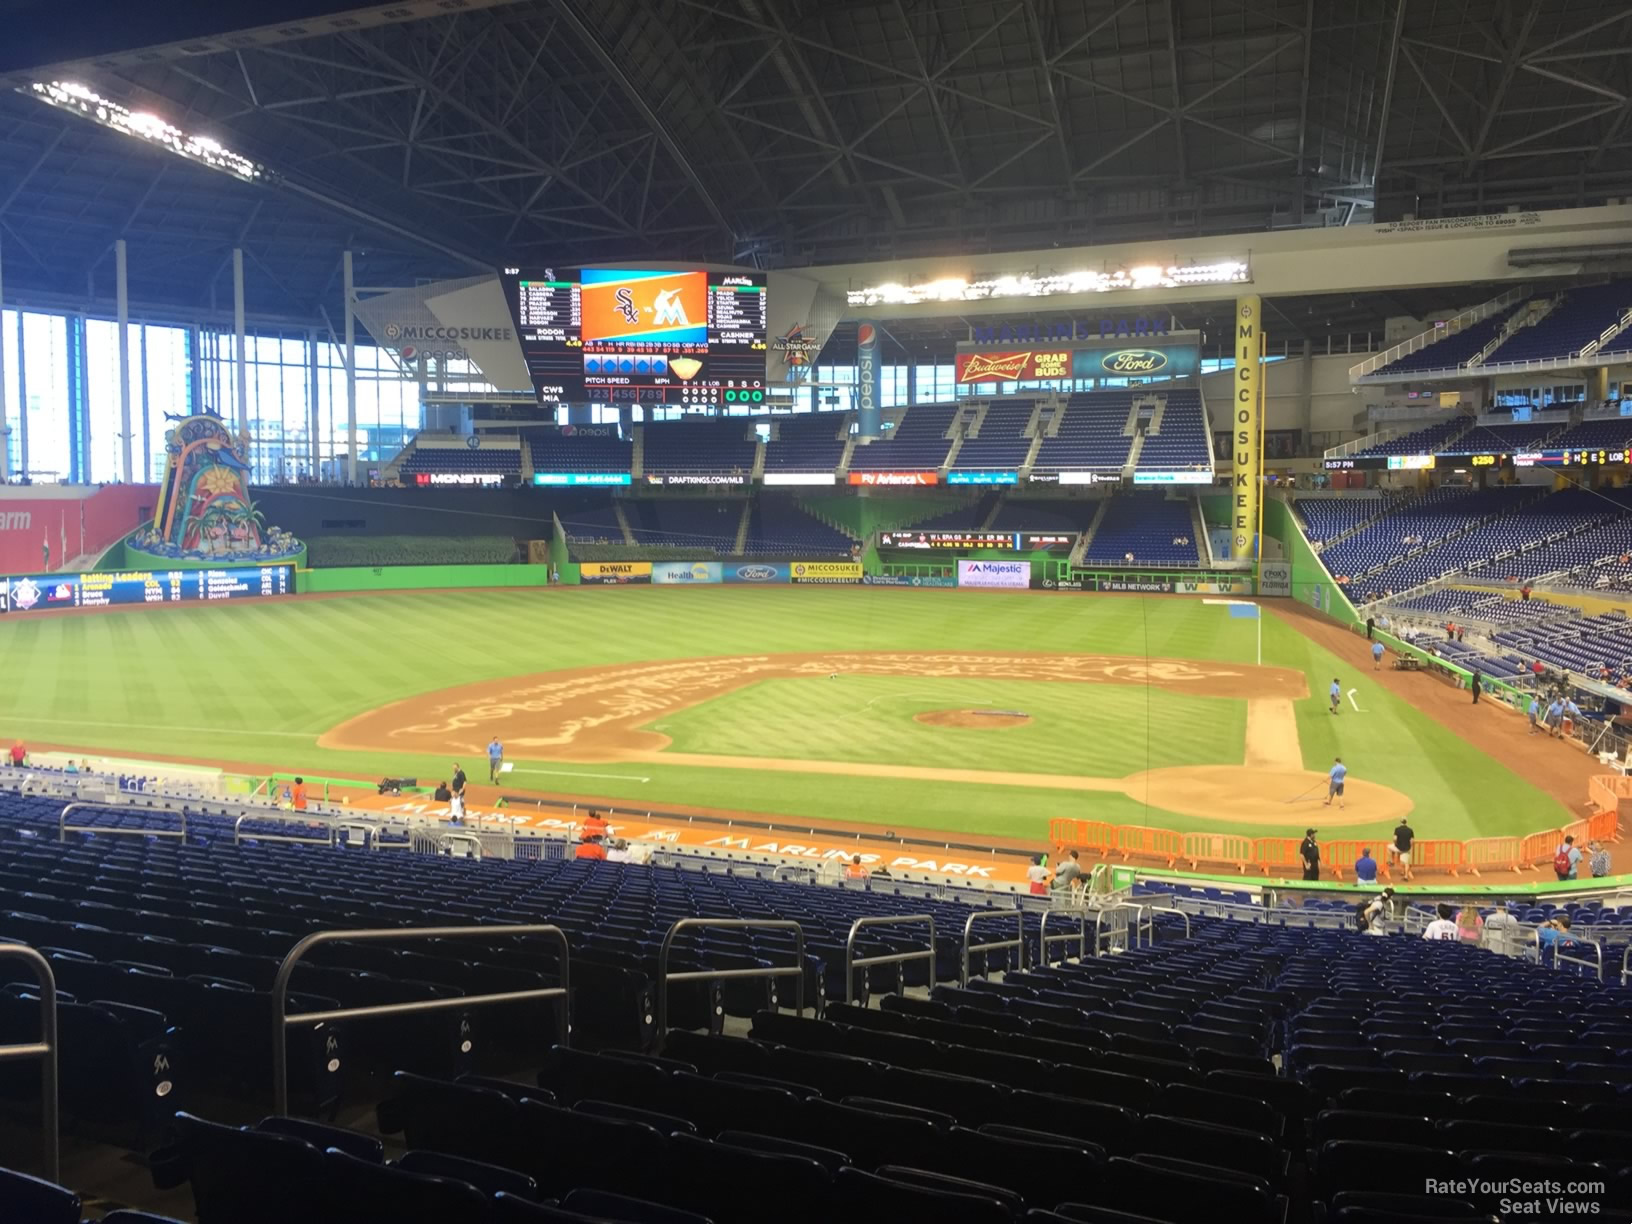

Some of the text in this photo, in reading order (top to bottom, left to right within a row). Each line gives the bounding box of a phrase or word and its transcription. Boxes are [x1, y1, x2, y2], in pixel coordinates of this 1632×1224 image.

[403, 326, 511, 341] MICCOSUKEE
[975, 315, 1169, 345] MARLINS PARK
[801, 343, 821, 351] GAME
[1034, 353, 1068, 363] GRAB
[1113, 353, 1156, 371] Ford
[963, 360, 1027, 374] Budweiser
[1034, 367, 1067, 377] BUDS
[753, 380, 761, 388] O
[860, 352, 875, 410] pepsi
[542, 386, 564, 394] CWS
[543, 394, 560, 402] MIA
[1236, 323, 1253, 530] MICCOSUKEE
[578, 427, 610, 437] pepsi
[1472, 455, 1495, 466] $250
[1573, 454, 1581, 462] H
[1591, 453, 1598, 462] E
[1608, 453, 1624, 462] LOB
[1325, 461, 1355, 469] 5:57 PM
[430, 474, 502, 484] MONSTER
[668, 476, 744, 484] DRAFTKINGS.COM/MLB
[743, 567, 770, 579] Ford
[807, 564, 860, 572] MICCOSUKEE
[982, 564, 1022, 575] Majestic
[1127, 583, 1161, 591] NETWORK
[1261, 581, 1289, 589] FLORIDA
[384, 802, 534, 825] MALINS
[704, 835, 999, 878] MARLINS PARK
